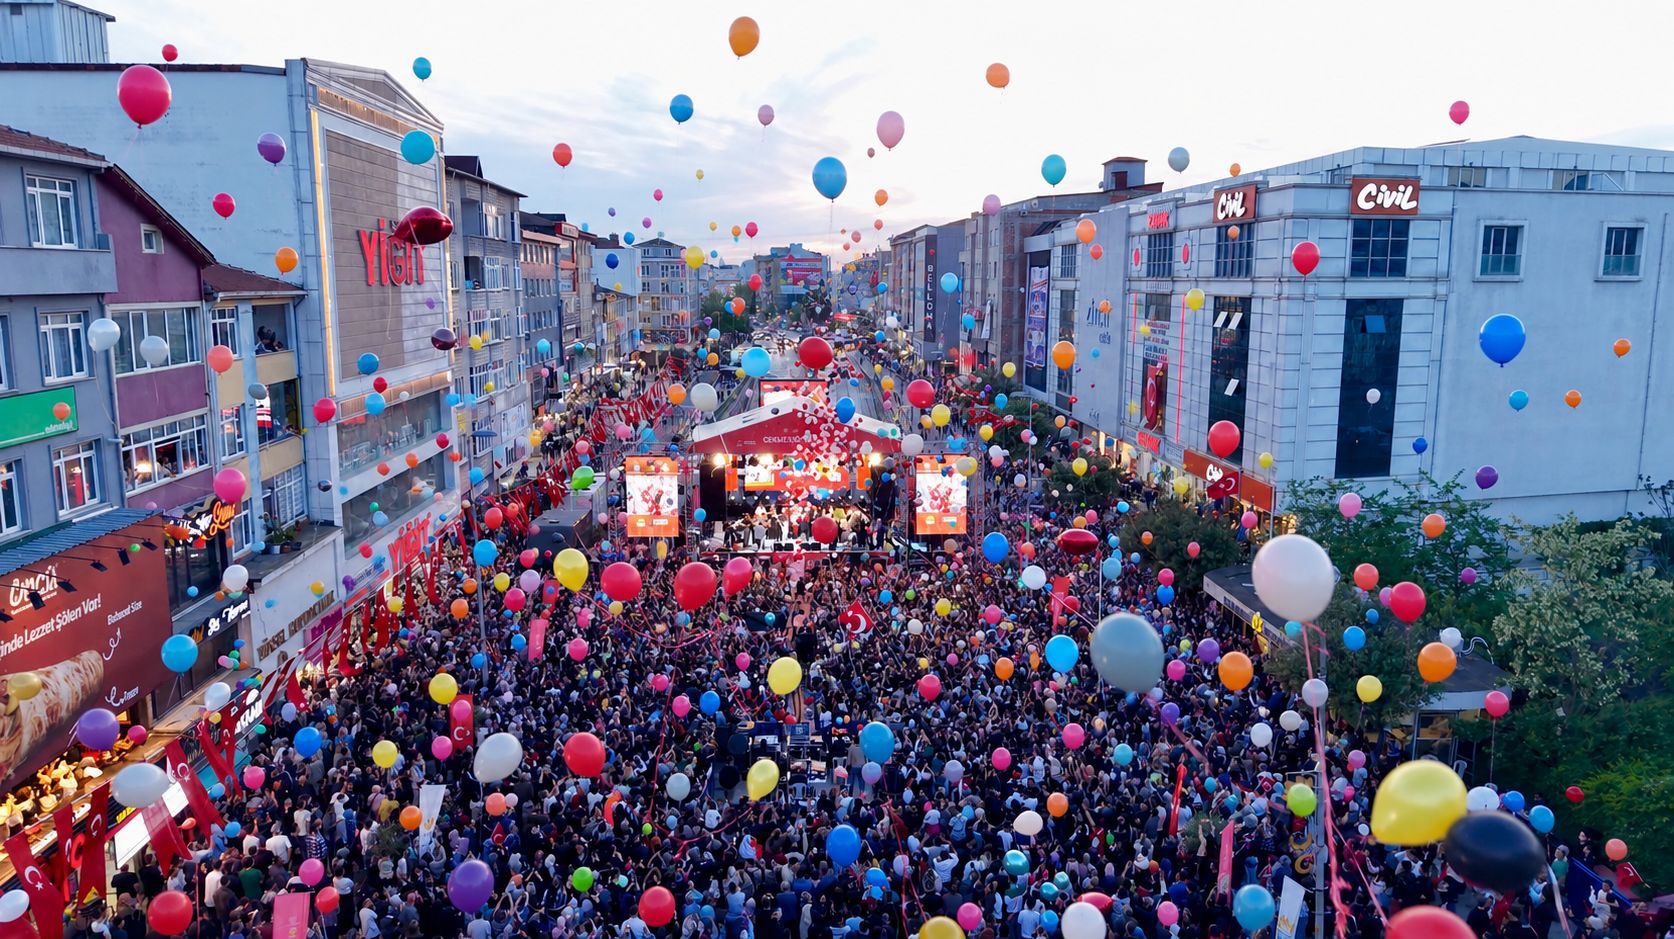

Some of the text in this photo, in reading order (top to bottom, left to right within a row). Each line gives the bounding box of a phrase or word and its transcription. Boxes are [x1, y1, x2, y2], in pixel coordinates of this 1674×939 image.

[24, 617, 56, 645] Lezzet
[55, 605, 82, 632] Şölen
[81, 593, 102, 614] Var!
